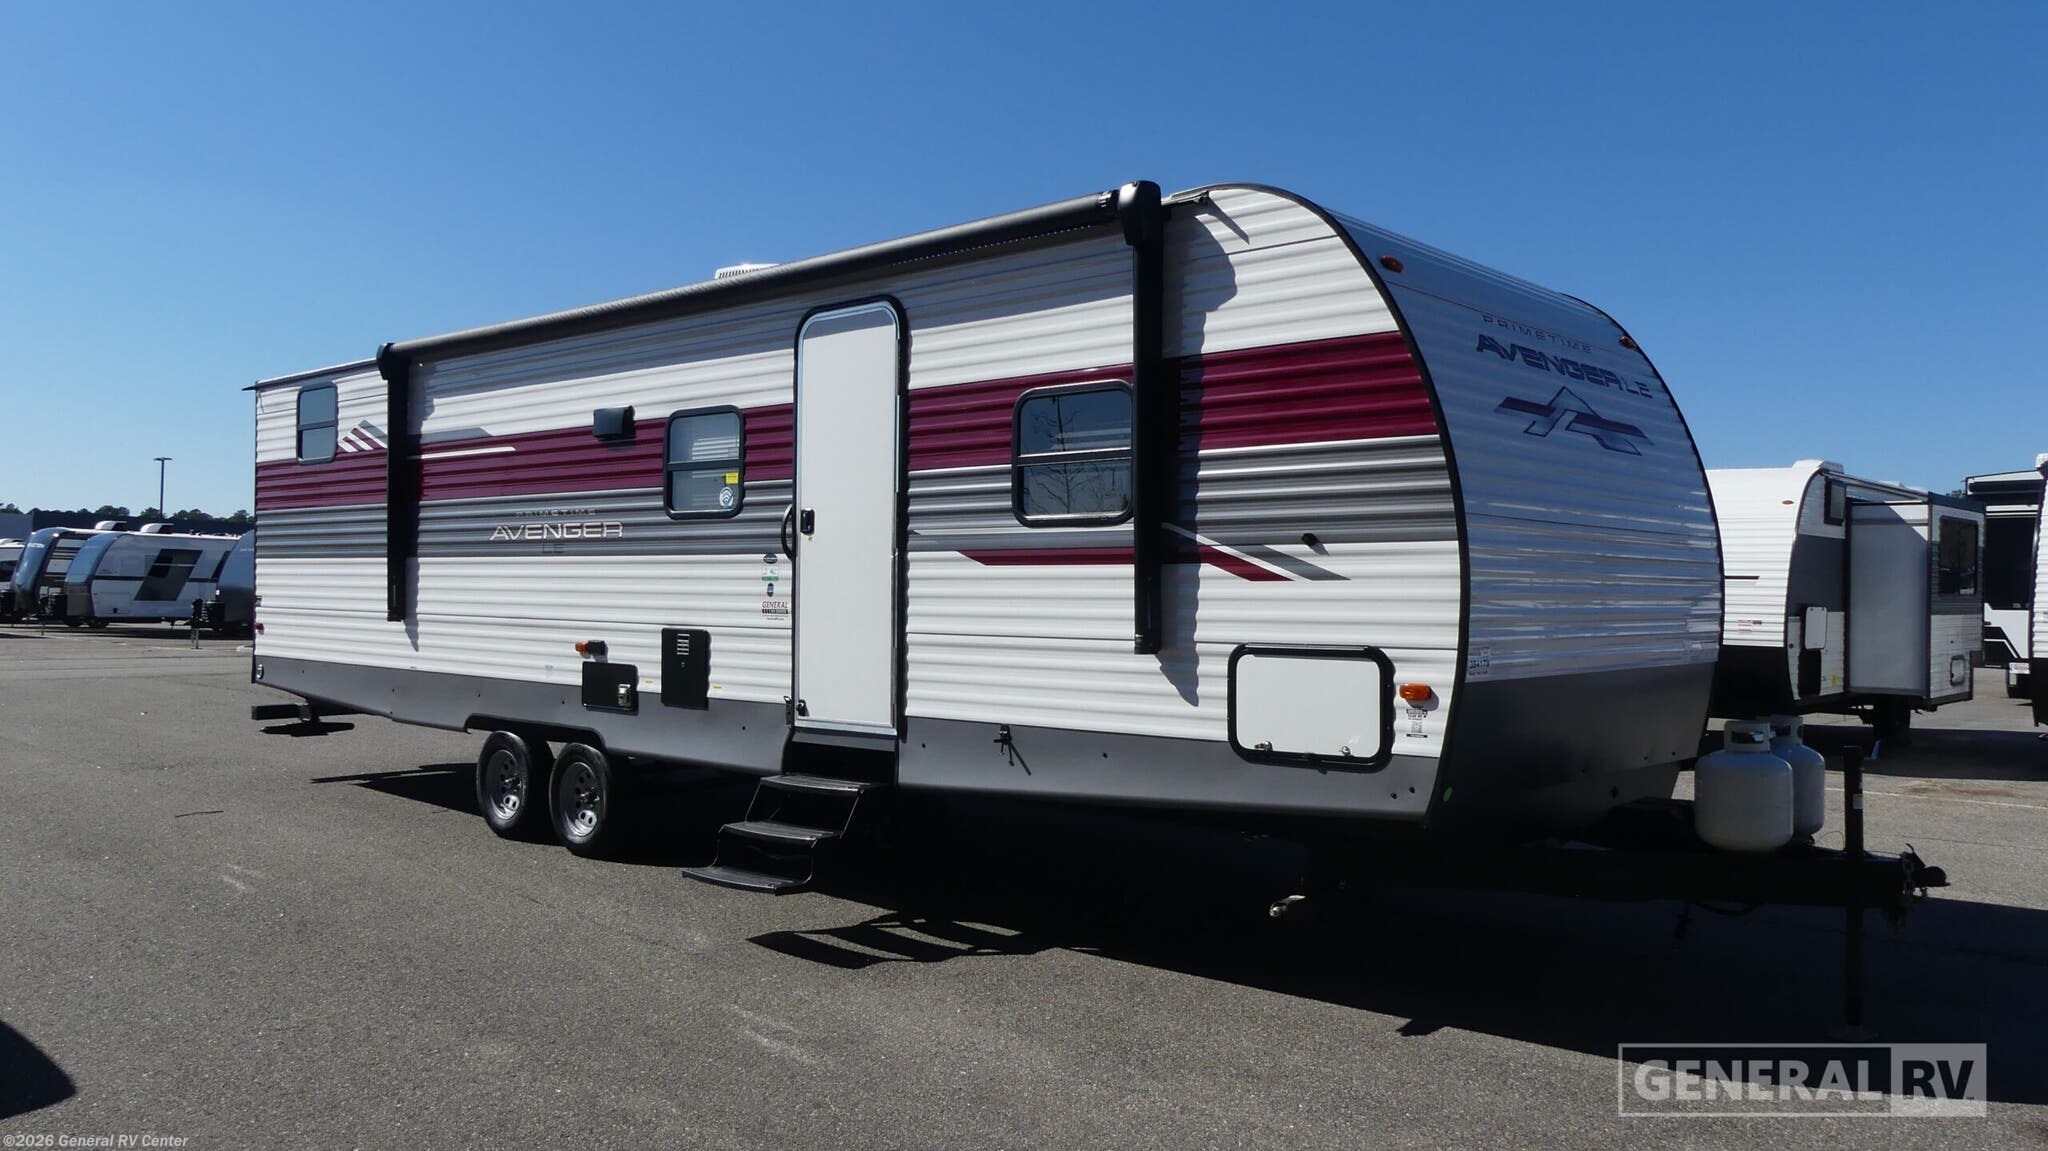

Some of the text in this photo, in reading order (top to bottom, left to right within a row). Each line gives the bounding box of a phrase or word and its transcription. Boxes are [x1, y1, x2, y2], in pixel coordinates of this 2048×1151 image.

[1482, 314, 1592, 353] PRIMETIME
[1475, 333, 1623, 391] AVENGER
[489, 521, 624, 541] AVENGER
